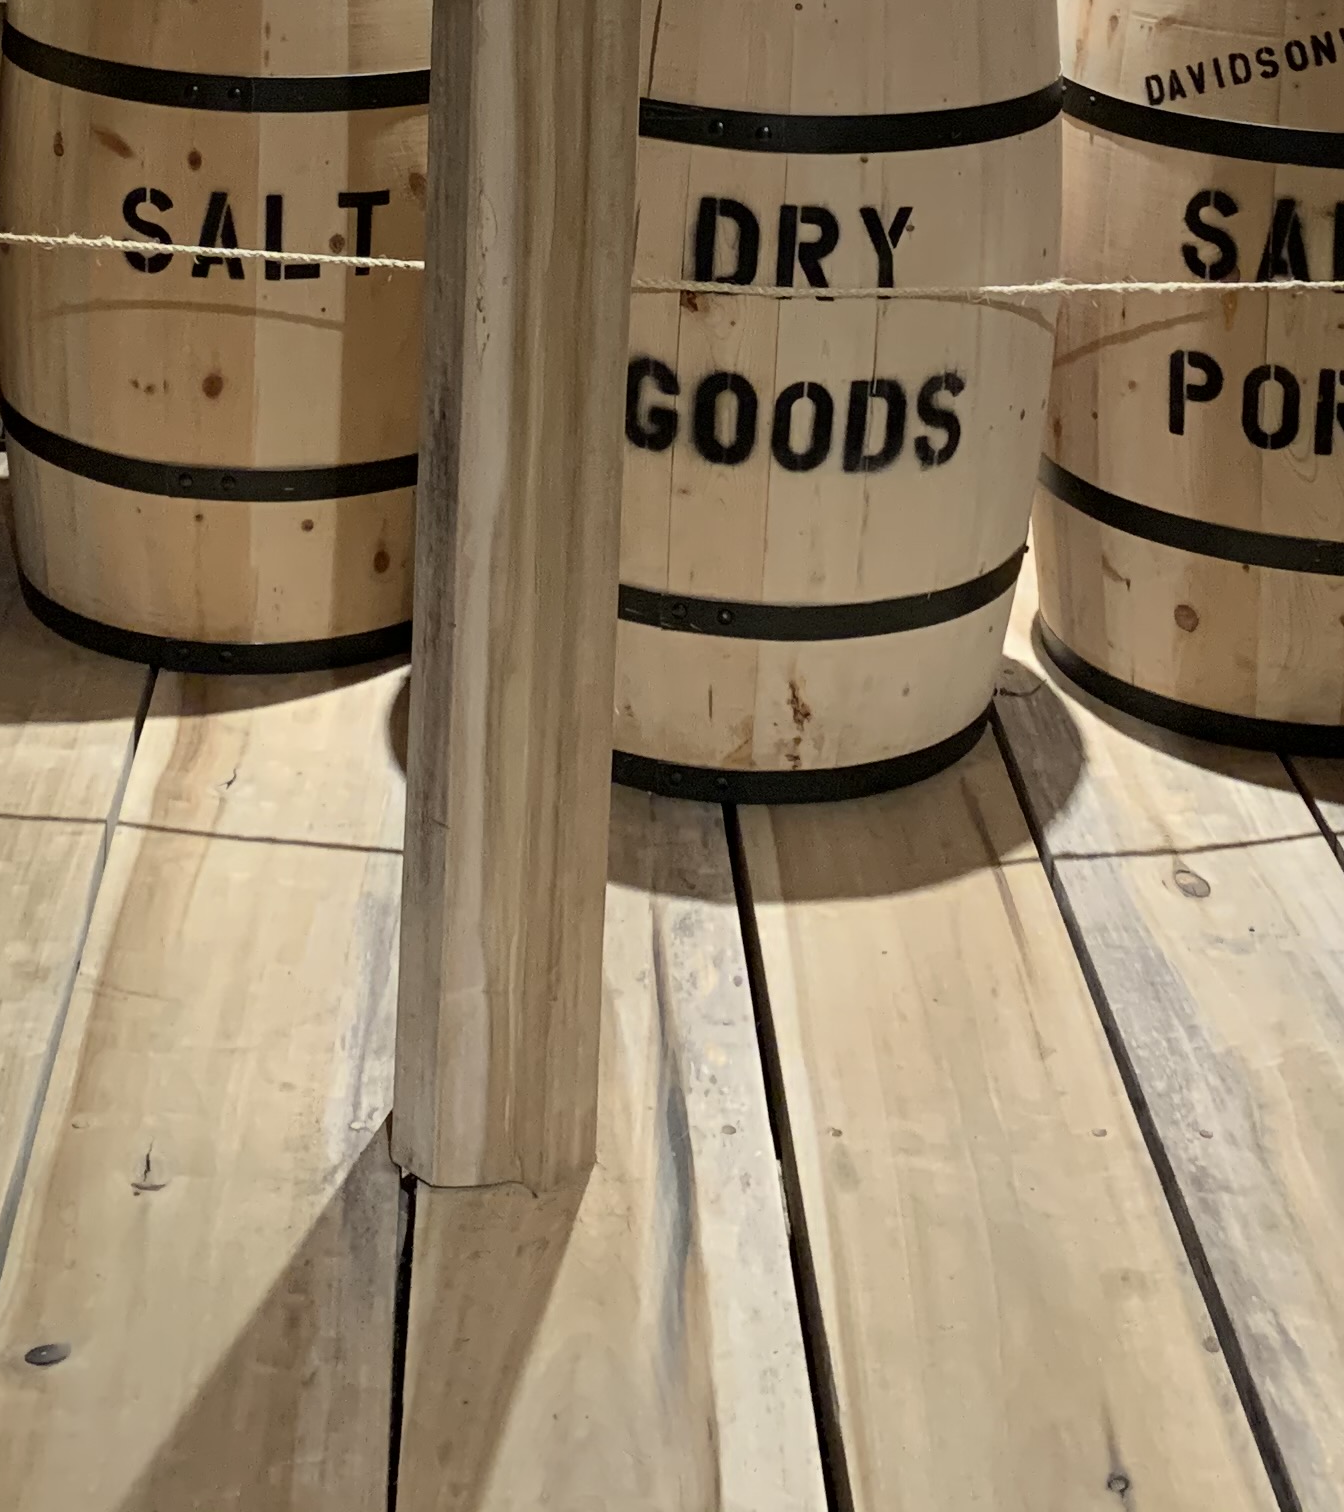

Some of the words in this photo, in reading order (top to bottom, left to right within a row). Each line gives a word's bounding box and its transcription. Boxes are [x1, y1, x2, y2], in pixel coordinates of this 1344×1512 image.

[121, 187, 391, 281] SALT
[693, 196, 914, 301] DRY
[625, 354, 966, 474] GOODS
